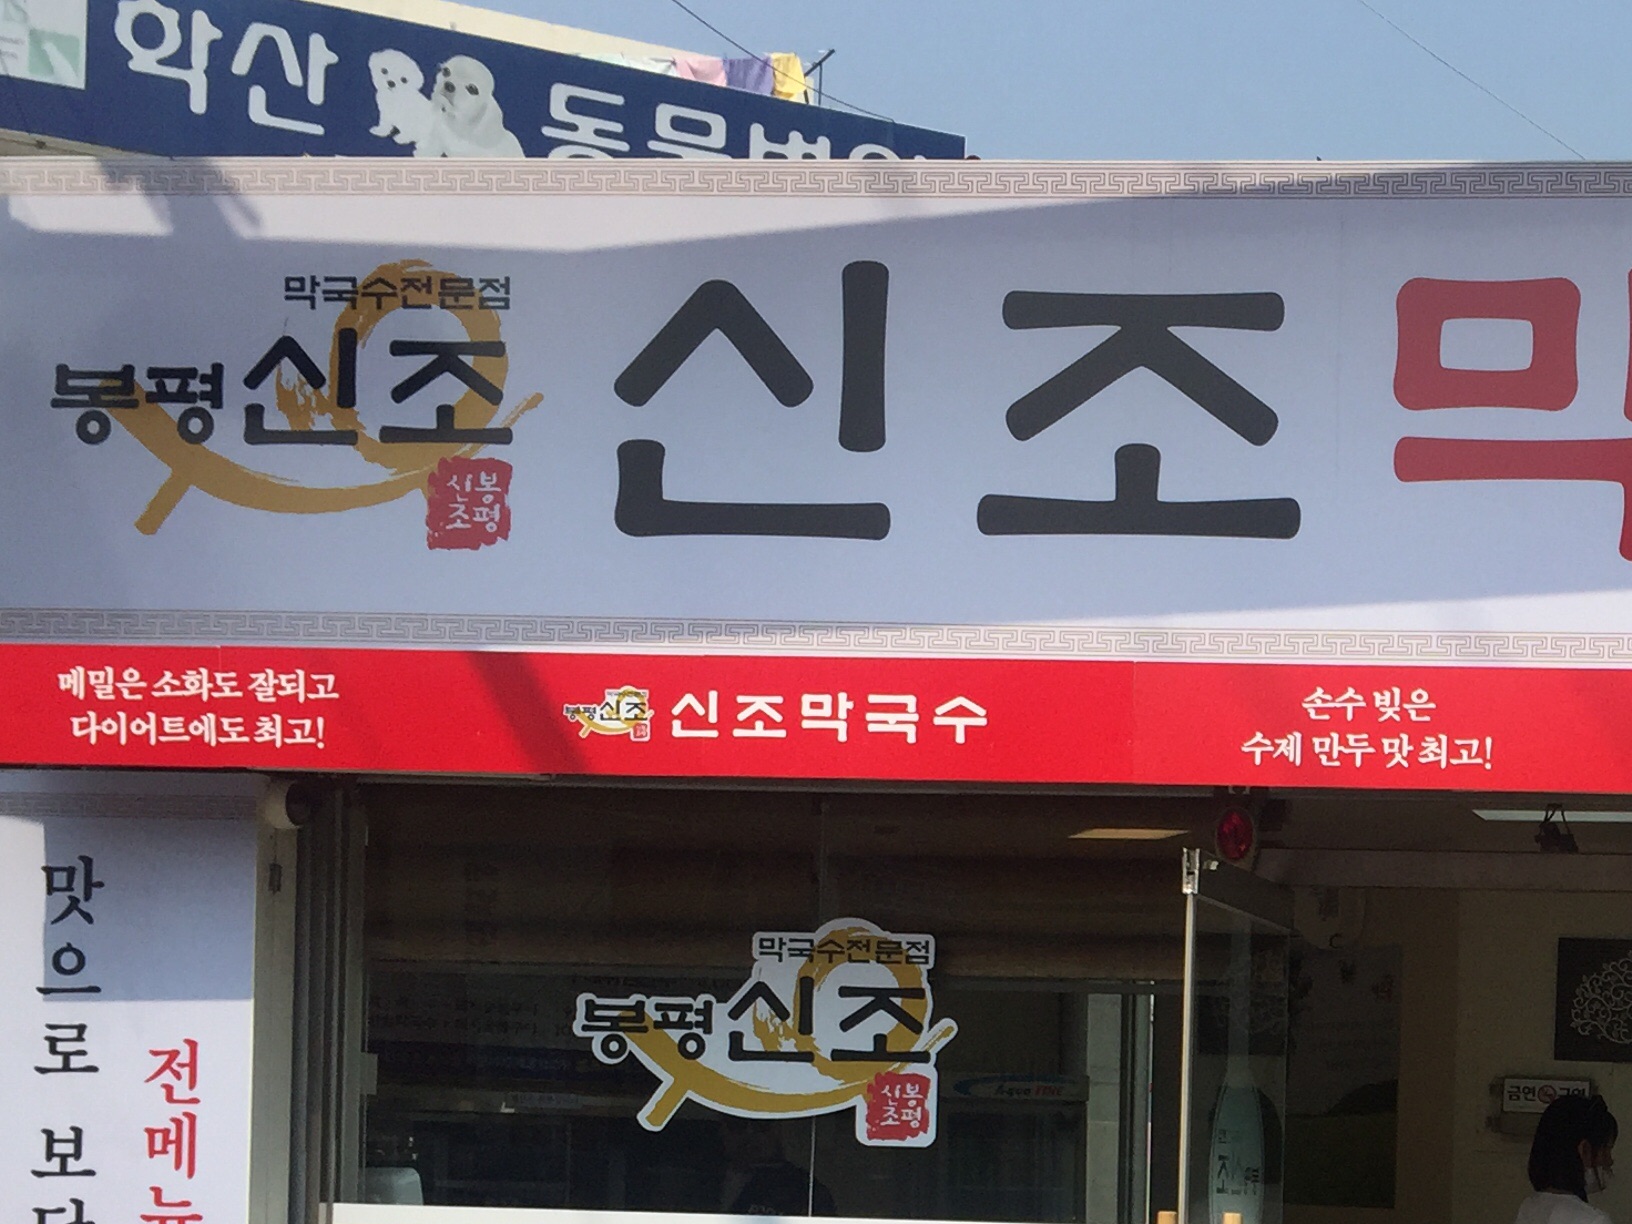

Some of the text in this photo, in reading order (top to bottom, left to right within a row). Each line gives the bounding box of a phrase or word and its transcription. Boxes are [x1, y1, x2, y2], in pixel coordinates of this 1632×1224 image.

[283, 274, 511, 311] 막국수전문점
[57, 667, 340, 705] 메밀은 소화도 잘되고
[671, 690, 987, 744] 신조막국수
[1301, 687, 1437, 723] 손수 빚은
[70, 713, 326, 750] 다이어트에도 최고!
[1240, 731, 1493, 771] 수제 만두 맛 최고!
[33, 855, 105, 1075] 맛으로
[757, 937, 931, 966] 막국수전문점
